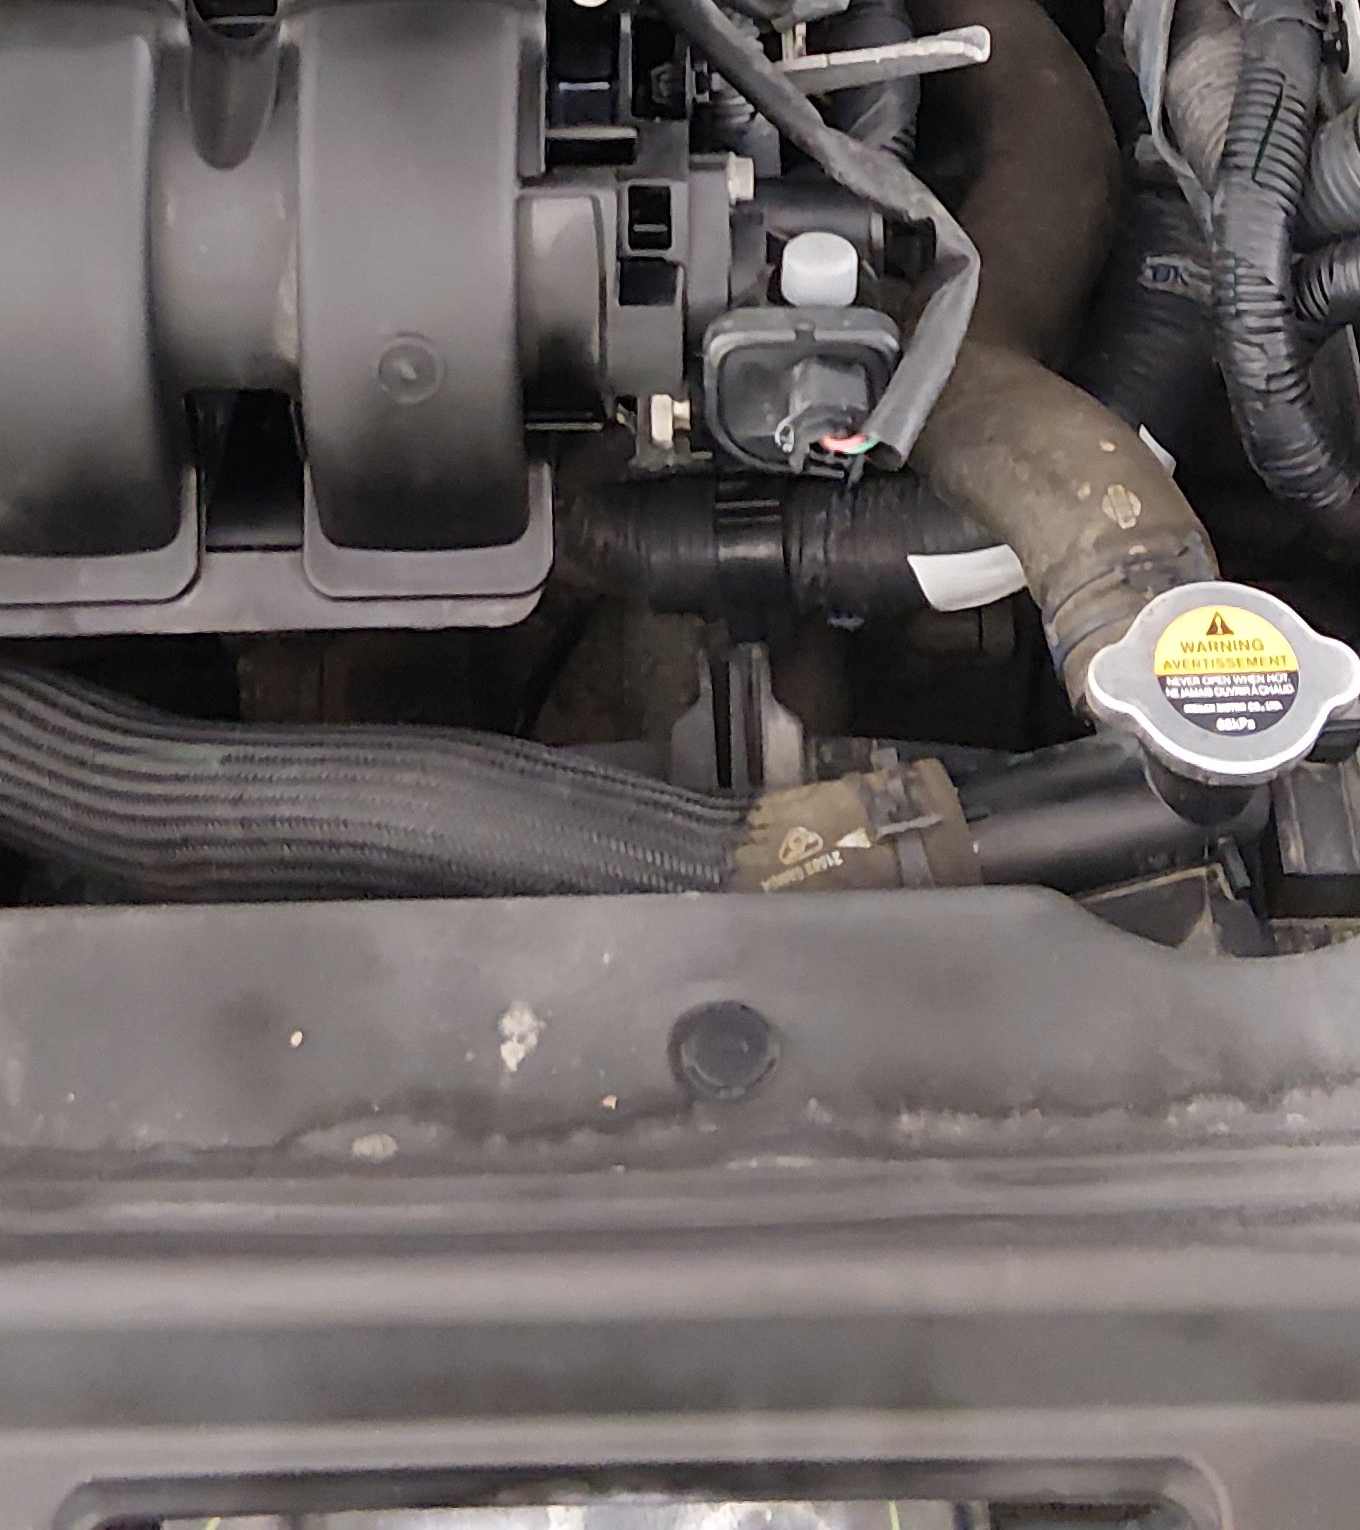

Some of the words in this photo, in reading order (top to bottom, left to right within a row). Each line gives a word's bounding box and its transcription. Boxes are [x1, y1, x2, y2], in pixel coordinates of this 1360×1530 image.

[1181, 639, 1264, 654] WARNING
[1164, 655, 1286, 670] AVERTISSEMENT
[1166, 676, 1200, 687] NEVER
[1202, 675, 1231, 685] OPEN
[1233, 674, 1265, 684] WHEN
